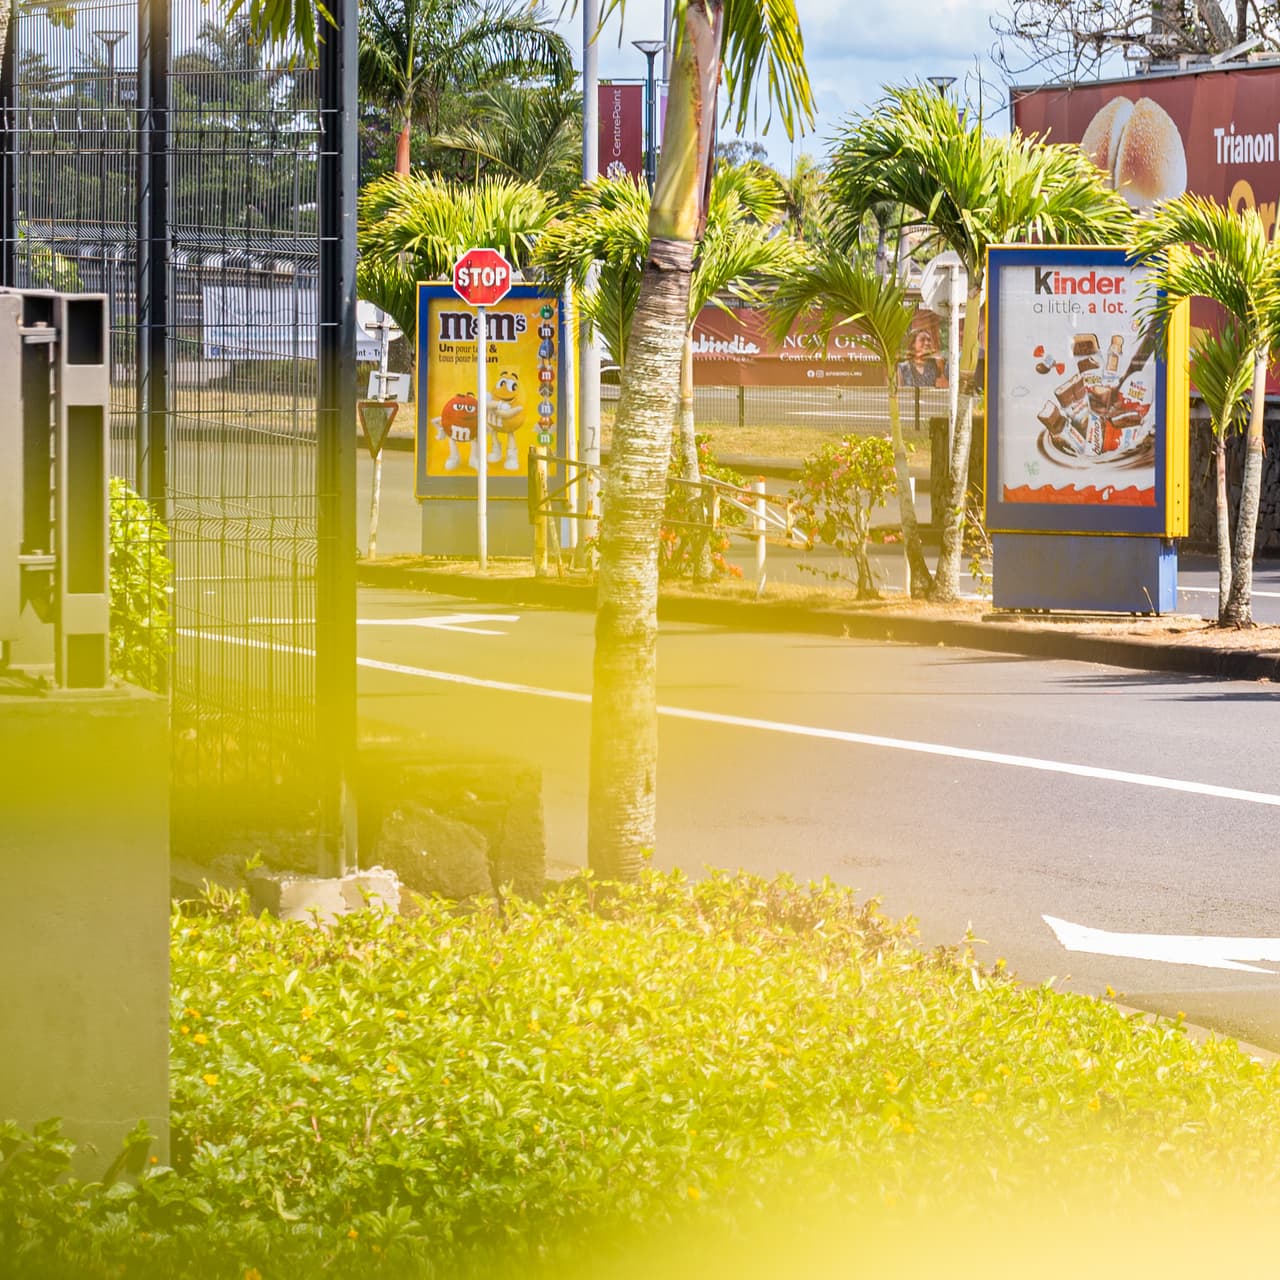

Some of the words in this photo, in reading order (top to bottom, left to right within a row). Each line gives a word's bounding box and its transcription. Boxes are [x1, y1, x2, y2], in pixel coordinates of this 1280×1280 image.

[612, 89, 622, 157] CentrePoint
[1213, 122, 1275, 164] Trianon
[457, 266, 507, 288] STOP
[1033, 303, 1043, 314] a
[1048, 299, 1085, 315] little,
[1088, 302, 1097, 314] a
[1103, 298, 1128, 314] lot.
[439, 344, 454, 353] Un
[456, 345, 471, 355] pour
[489, 344, 497, 353] &
[450, 425, 471, 440] m
